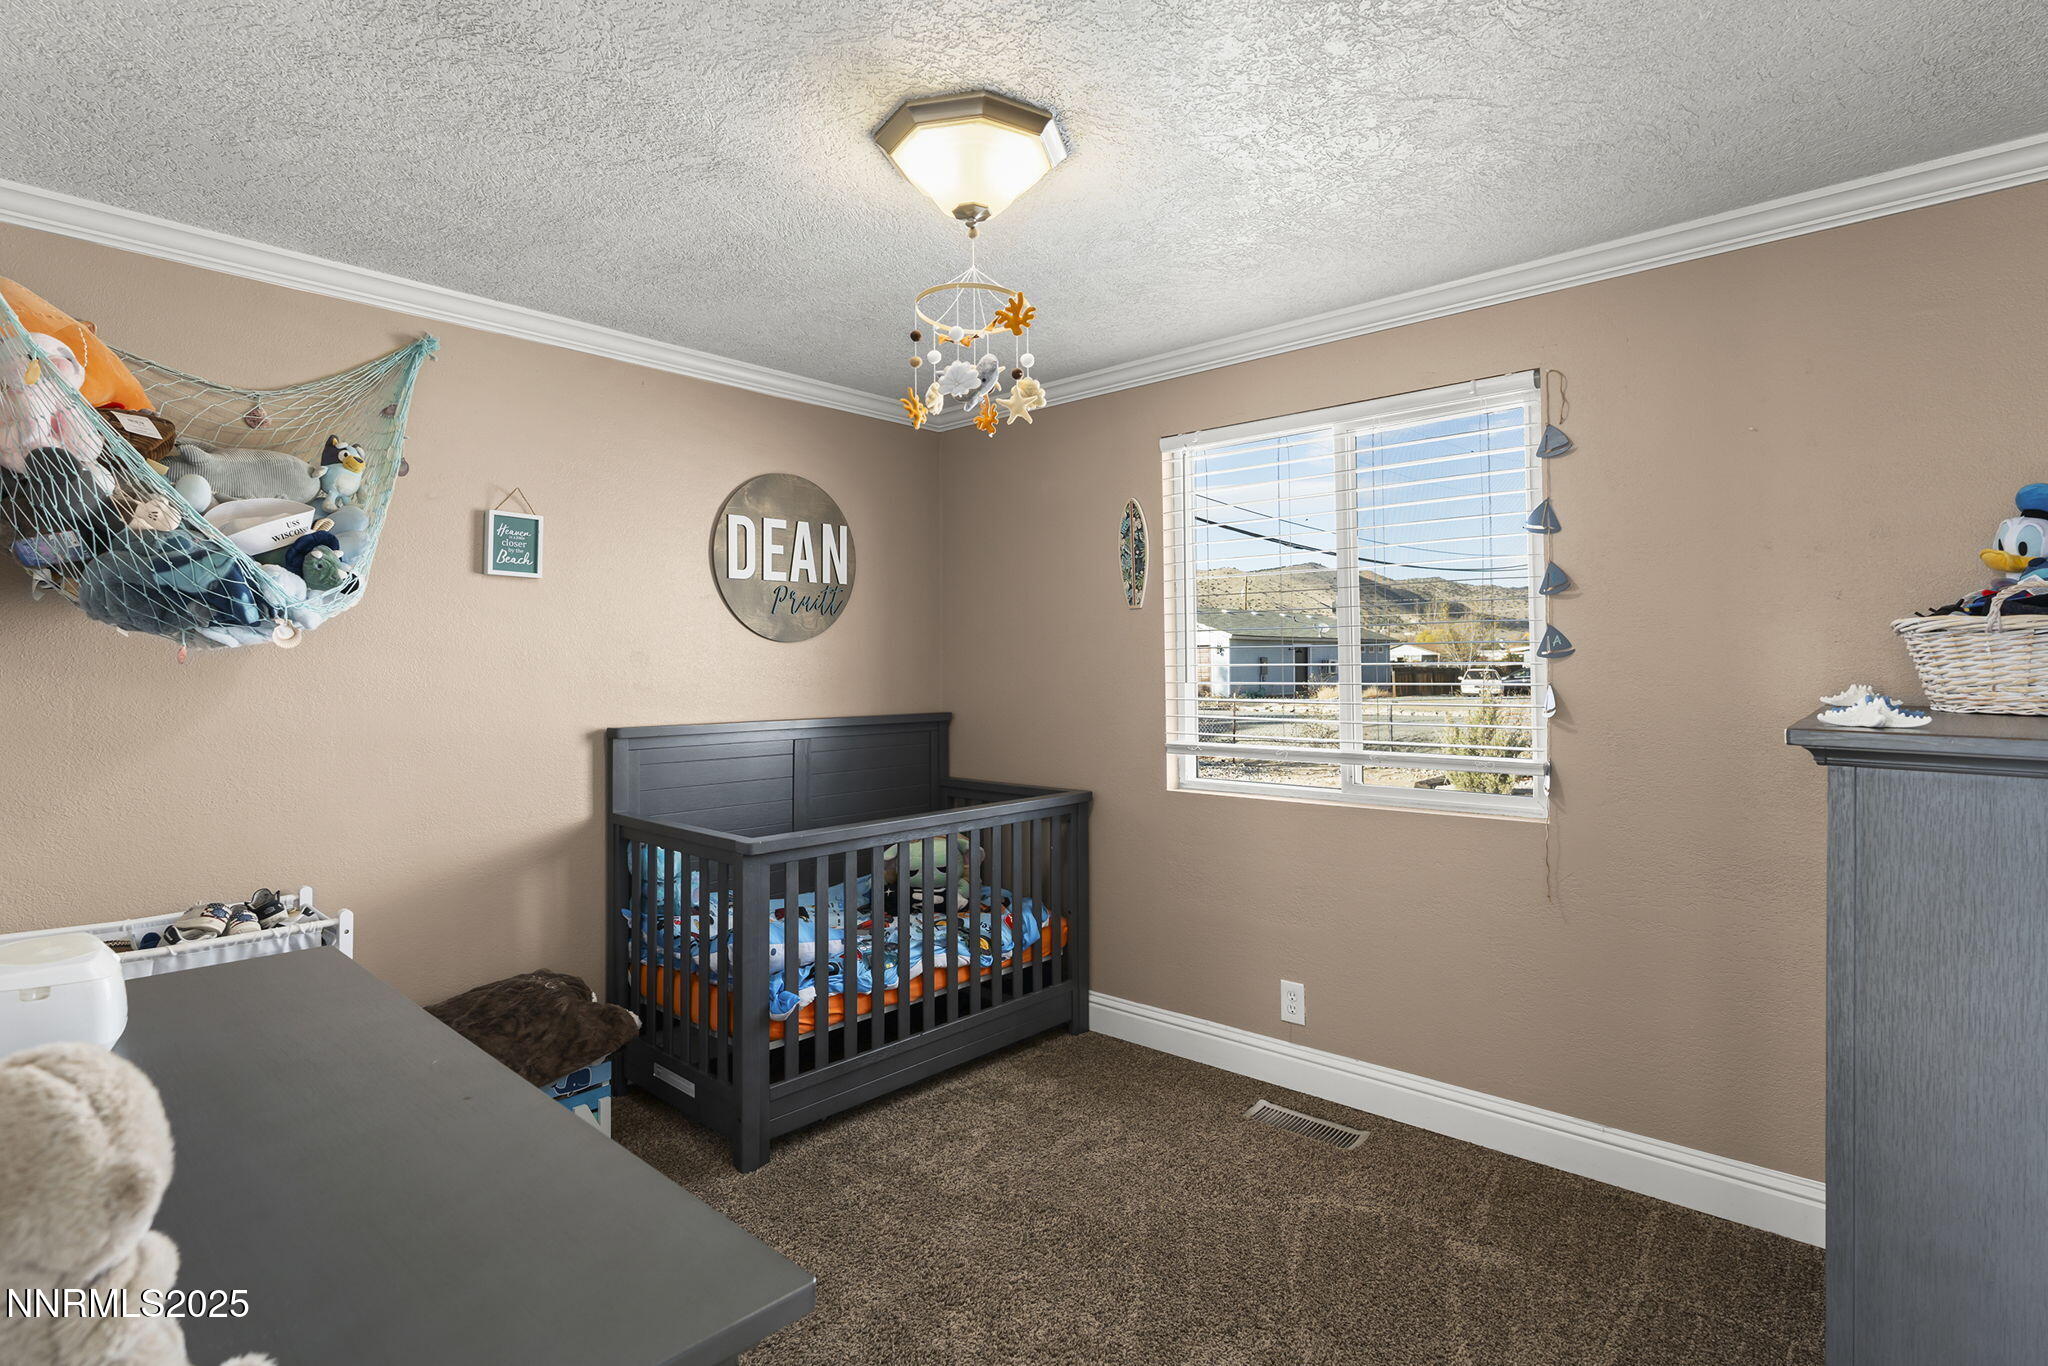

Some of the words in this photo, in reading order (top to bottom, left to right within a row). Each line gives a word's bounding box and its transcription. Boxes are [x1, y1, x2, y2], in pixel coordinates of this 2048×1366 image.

[286, 519, 301, 529] USS
[497, 523, 532, 537] Heaven
[501, 539, 527, 548] closer
[727, 513, 848, 585] DEAN
[496, 548, 534, 566] Beach
[771, 585, 844, 616] Pruitt
[1553, 635, 1562, 647] A
